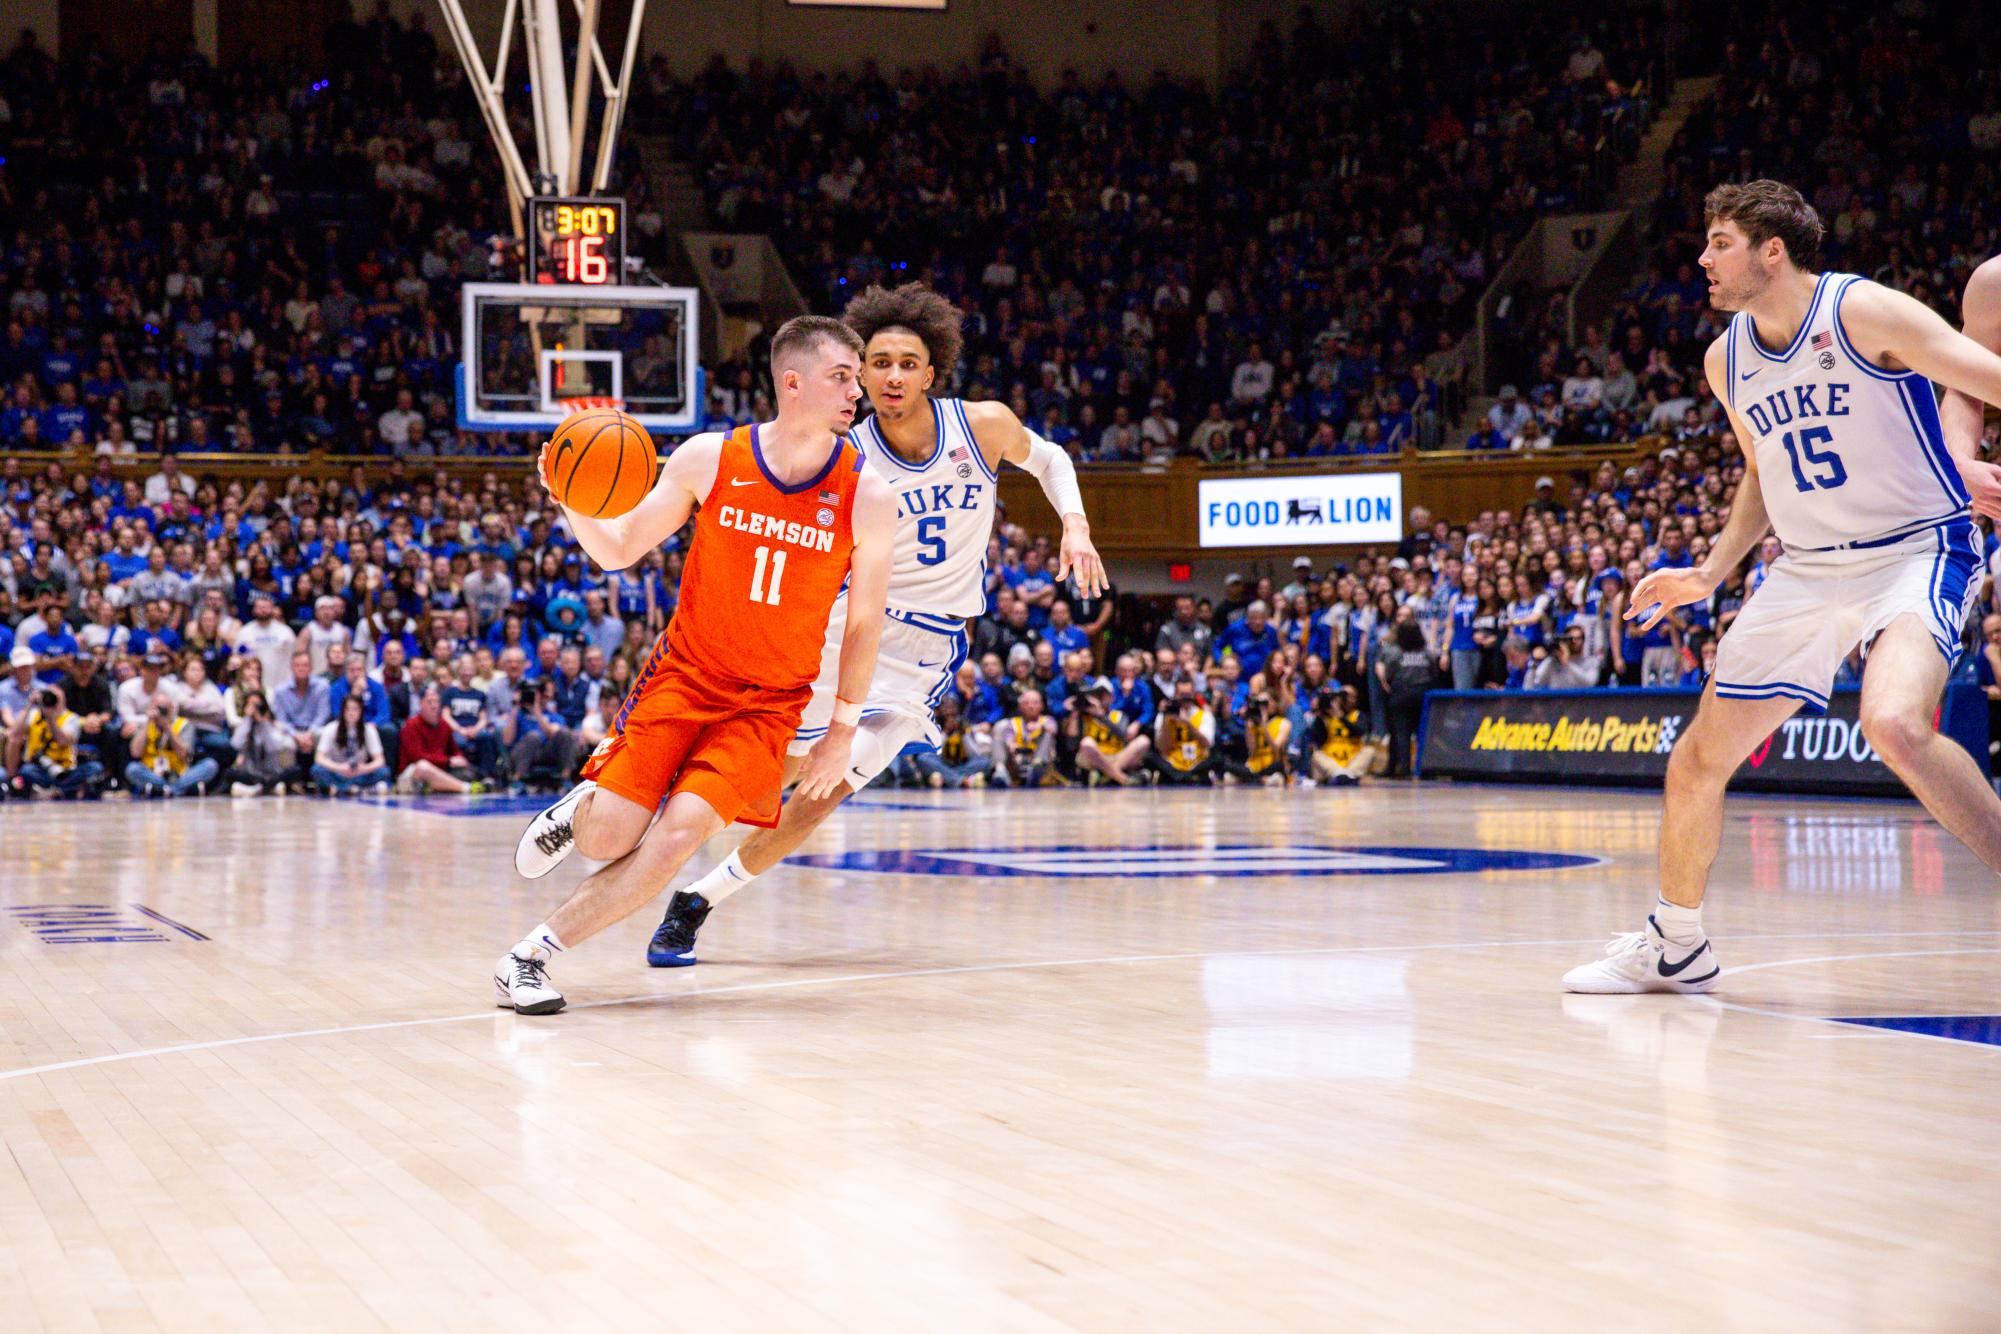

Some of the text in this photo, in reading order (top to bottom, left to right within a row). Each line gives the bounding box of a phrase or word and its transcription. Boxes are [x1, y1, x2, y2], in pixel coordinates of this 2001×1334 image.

[557, 205, 616, 235] 3:07
[566, 236, 608, 284] 16
[1746, 382, 1850, 437] DUKE
[1782, 425, 1848, 493] 15
[897, 484, 982, 519] UKE
[1208, 497, 1392, 527] FOOD LION
[719, 505, 835, 552] CLEMSON
[916, 516, 947, 566] 5
[749, 545, 787, 606] 11
[1470, 716, 1658, 752] Advance Auto Parts
